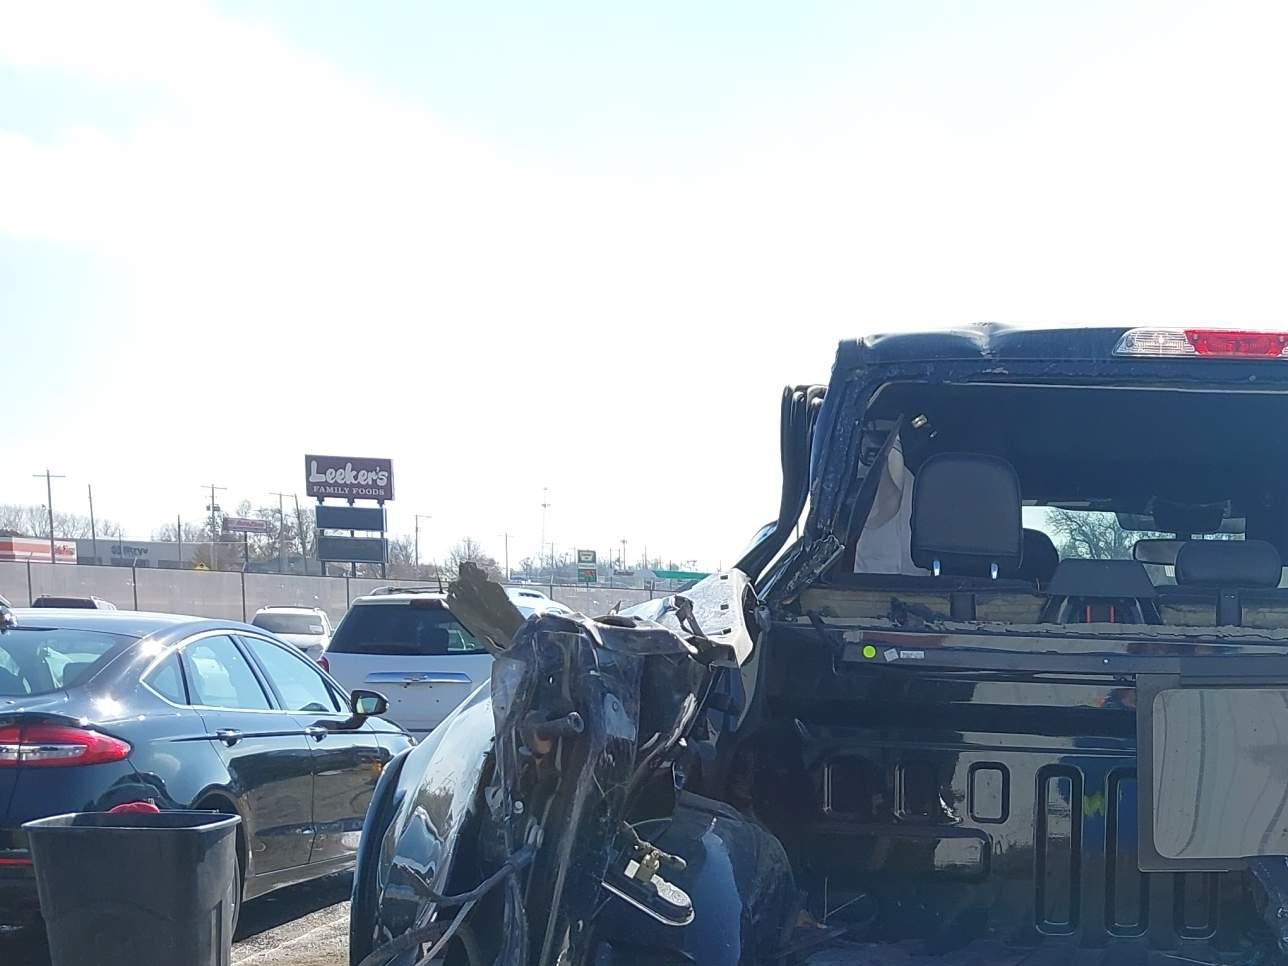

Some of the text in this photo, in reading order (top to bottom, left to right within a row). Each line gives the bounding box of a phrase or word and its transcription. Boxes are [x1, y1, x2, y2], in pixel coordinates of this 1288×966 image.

[309, 460, 388, 486] Leeker's
[313, 485, 385, 496] FAMILY FOODS
